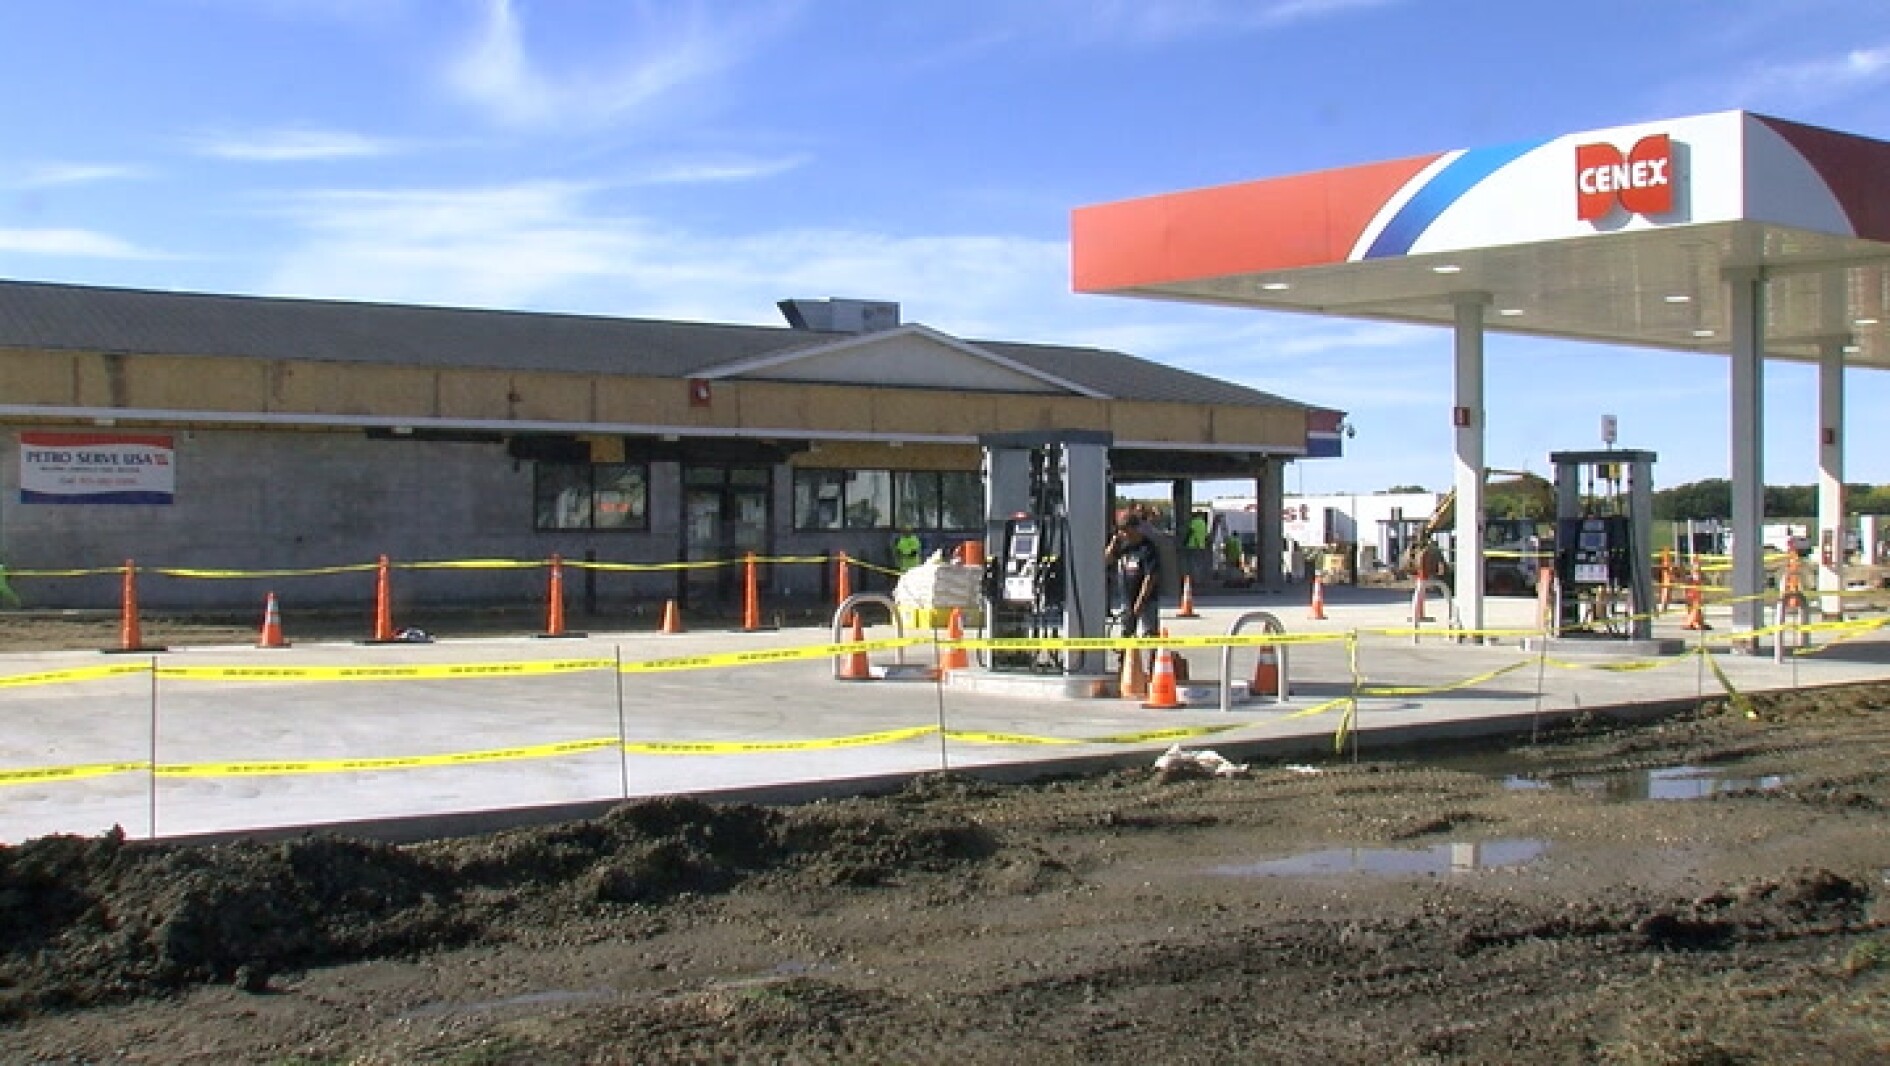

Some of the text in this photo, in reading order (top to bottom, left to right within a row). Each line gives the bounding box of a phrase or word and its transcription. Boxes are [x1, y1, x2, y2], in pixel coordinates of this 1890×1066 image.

[1579, 157, 1668, 194] CENEX
[26, 451, 72, 463] PETRO
[76, 452, 119, 466] SERVE
[123, 453, 153, 466] USA
